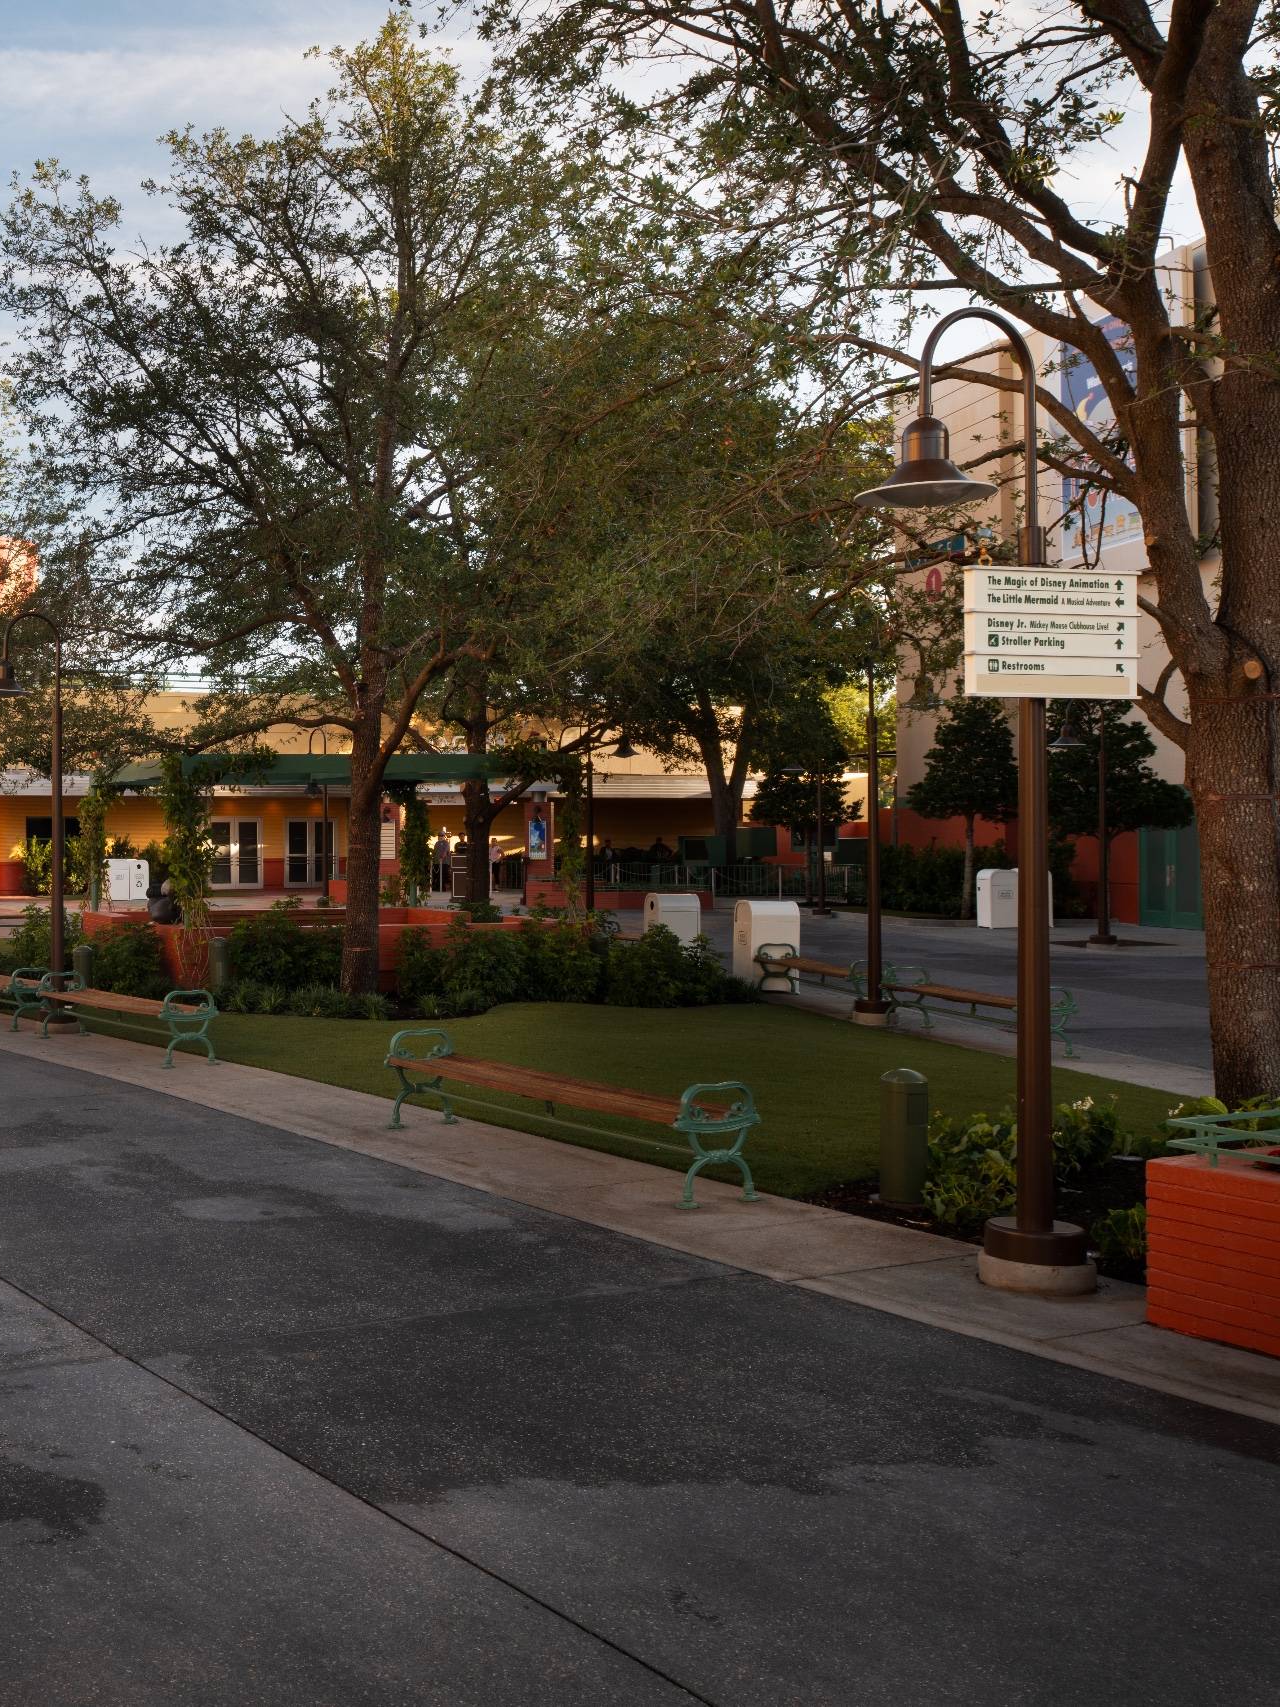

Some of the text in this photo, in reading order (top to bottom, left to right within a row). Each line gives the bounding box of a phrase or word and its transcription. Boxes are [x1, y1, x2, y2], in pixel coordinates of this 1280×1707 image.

[987, 575, 1110, 590] The Magic of Disney Animation
[987, 593, 1001, 603] The
[1002, 593, 1023, 604] Little
[1024, 594, 1059, 605] Mermaid
[1066, 597, 1085, 606] Musical
[1085, 597, 1111, 607] Adventure
[987, 617, 1110, 631] Disney Jr. Mickey Mouse Clubhouse Live!
[1001, 635, 1065, 649] Stroller Parking
[1001, 660, 1045, 671] Restrooms
